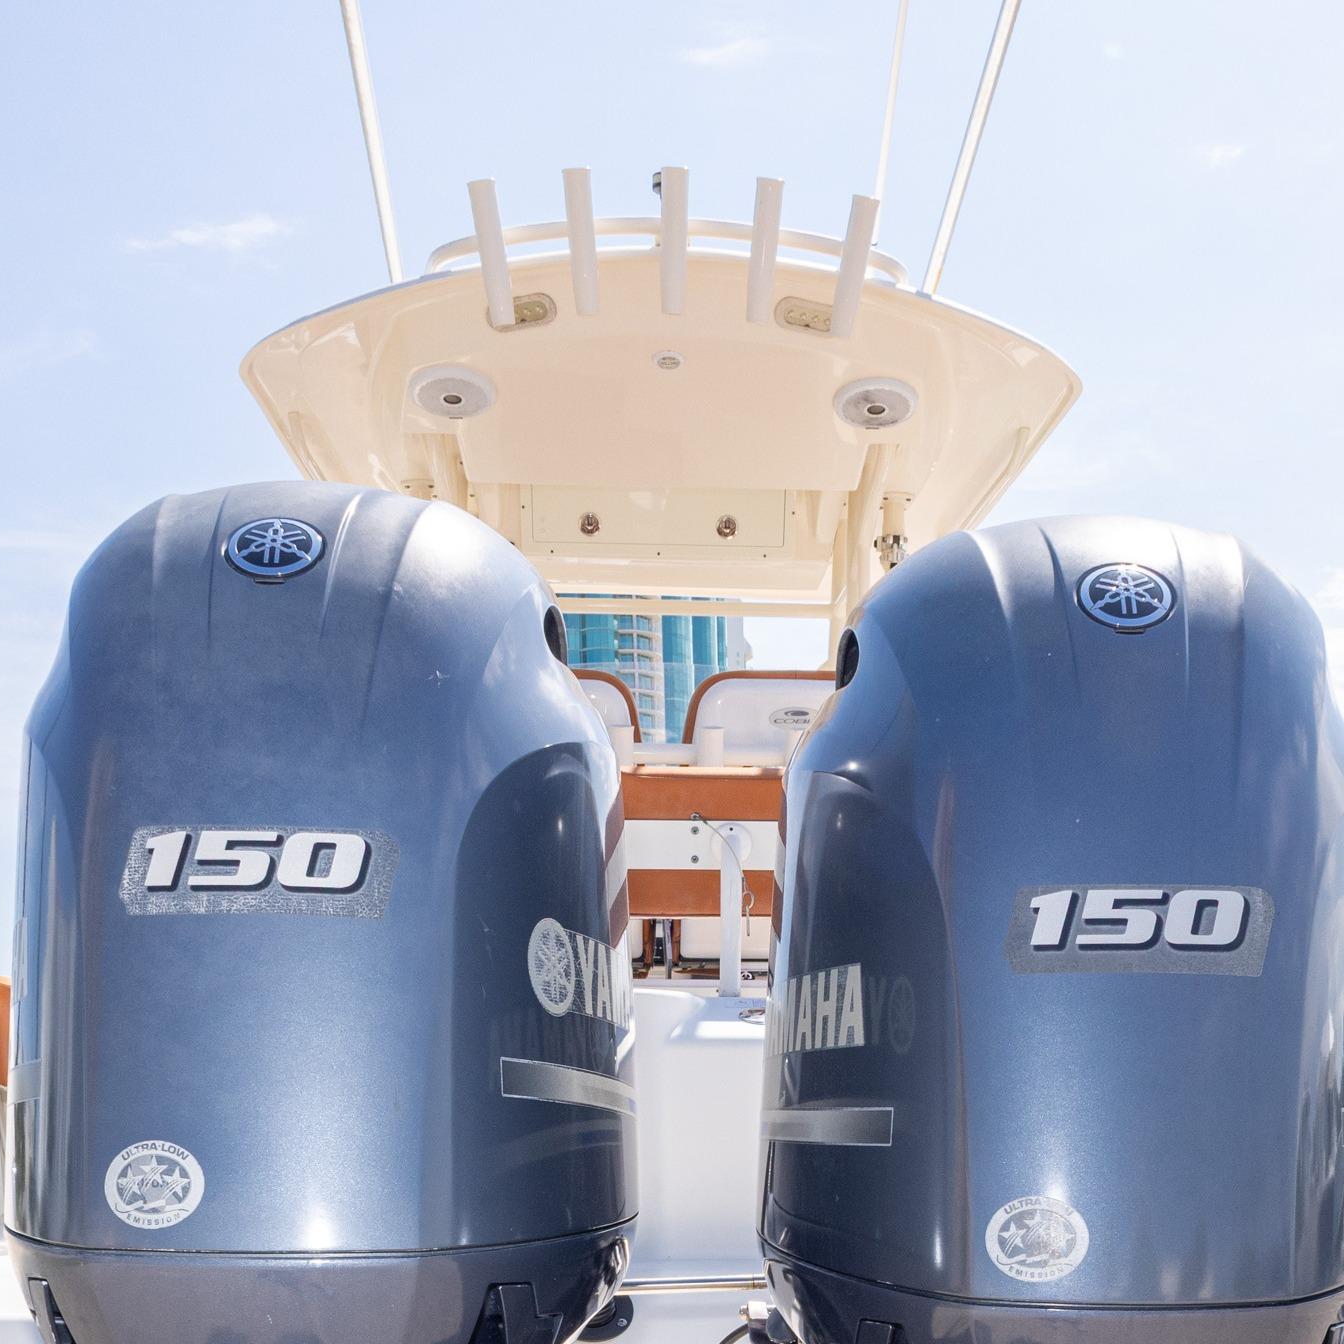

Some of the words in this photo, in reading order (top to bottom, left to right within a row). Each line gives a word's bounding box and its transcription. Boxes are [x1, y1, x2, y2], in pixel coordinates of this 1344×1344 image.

[144, 831, 372, 895] 150
[1030, 889, 1250, 952] 150
[767, 964, 865, 1056] AMAHA
[126, 1212, 181, 1226] EMISSION
